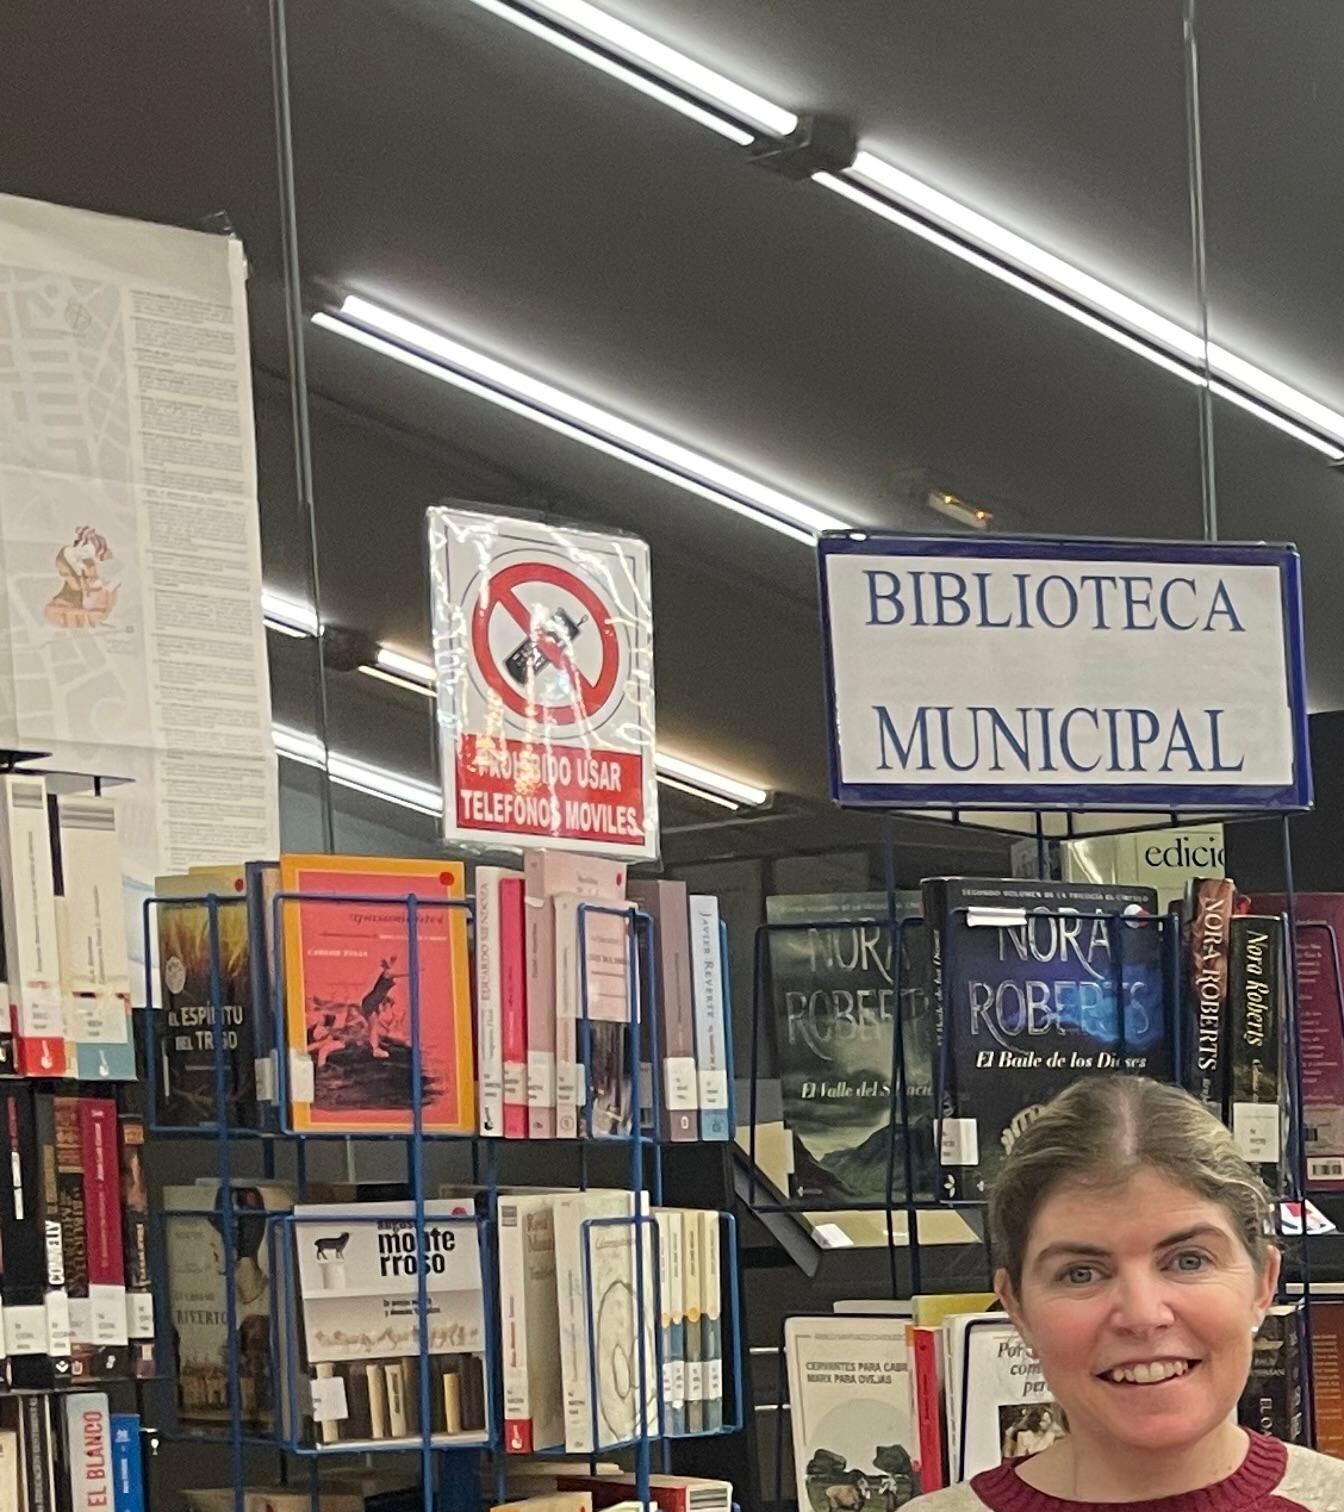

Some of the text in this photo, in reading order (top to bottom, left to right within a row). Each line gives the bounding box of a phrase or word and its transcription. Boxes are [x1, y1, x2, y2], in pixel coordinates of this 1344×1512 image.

[863, 569, 1246, 633] BIBLIOTECA
[876, 704, 1245, 773] MUNICIPAL
[474, 751, 621, 791] PROHBIDO USAR
[566, 801, 640, 835] MOVILES
[1000, 907, 1111, 980] NORA
[1197, 897, 1223, 1070] NORA ROBERTS
[1246, 930, 1270, 1047] Nora Roberts
[195, 1031, 238, 1050] TRGO
[976, 1052, 992, 1068] El
[998, 1051, 1043, 1068] Baile
[1046, 1051, 1066, 1068] de
[1070, 1051, 1092, 1068] los
[856, 1081, 877, 1096] del
[378, 1229, 456, 1253] mote
[379, 1252, 445, 1277] rroo
[806, 1362, 908, 1372] CERVANTES PARA CABR
[807, 1374, 892, 1384] MARX PARA OVEJAS
[83, 1411, 103, 1480] BLANCO
[88, 1486, 107, 1506] EL
